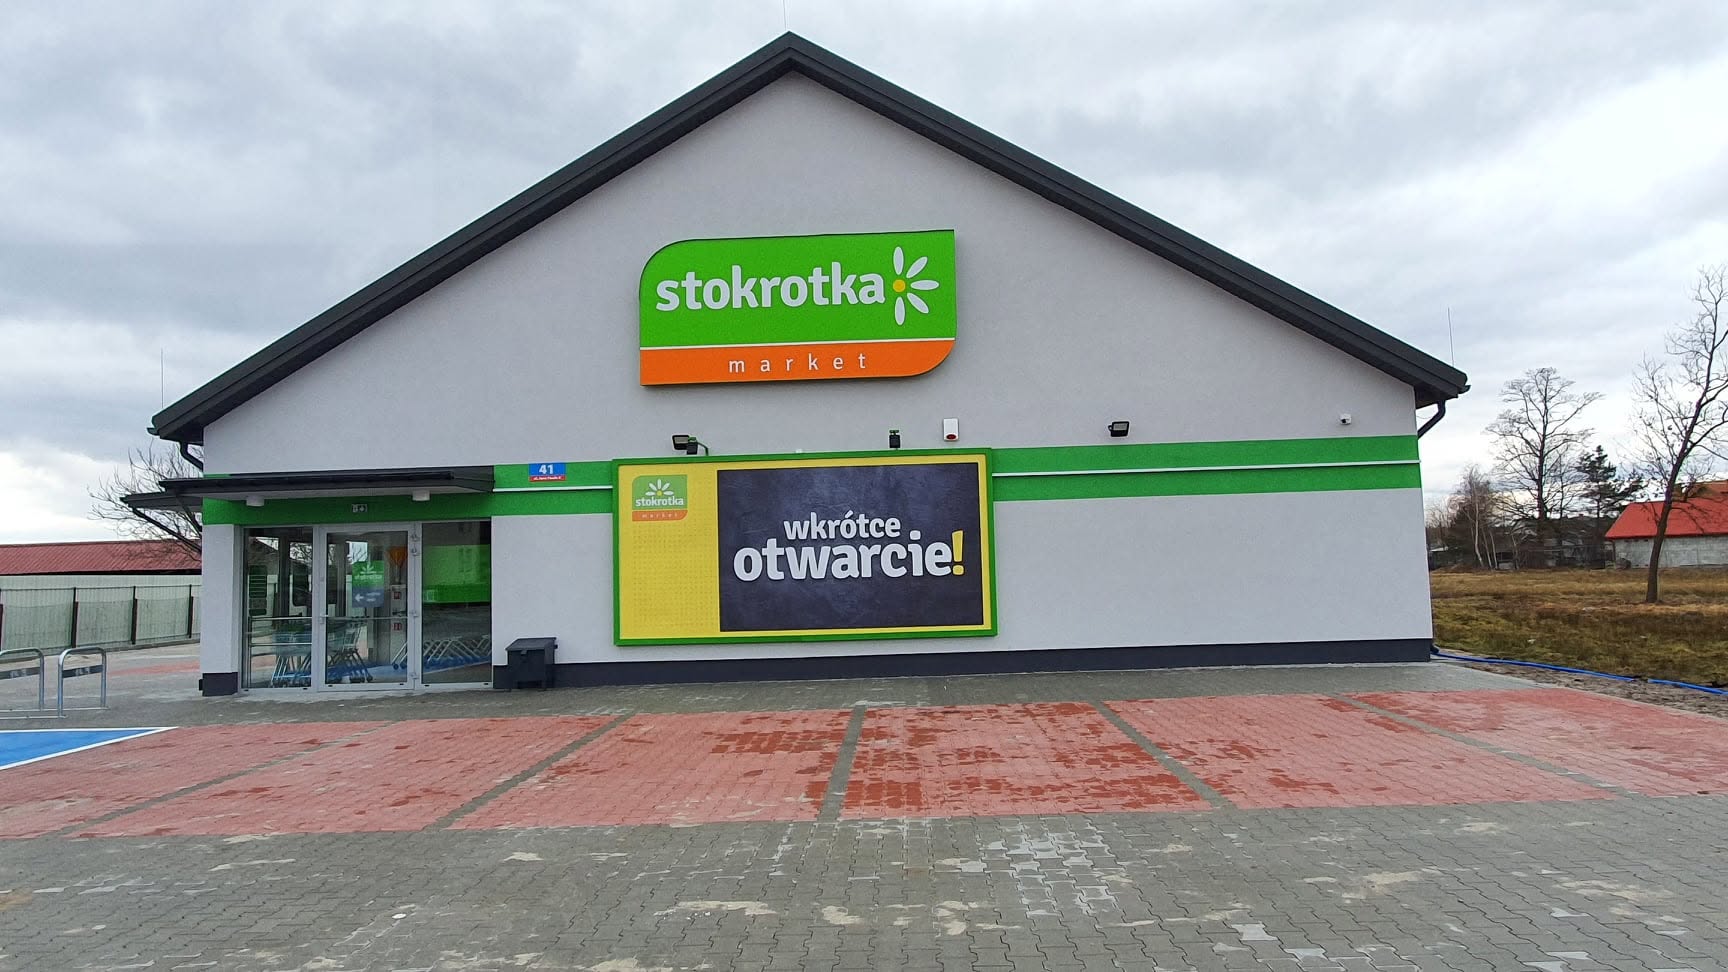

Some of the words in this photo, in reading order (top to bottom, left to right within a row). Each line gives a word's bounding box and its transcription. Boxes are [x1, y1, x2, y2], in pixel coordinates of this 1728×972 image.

[656, 262, 885, 311] stokrotka
[728, 353, 866, 373] market
[538, 464, 554, 475] 41
[635, 496, 684, 507] stokrotka
[783, 510, 901, 540] wkrótce
[733, 530, 965, 582] otwarcie!
